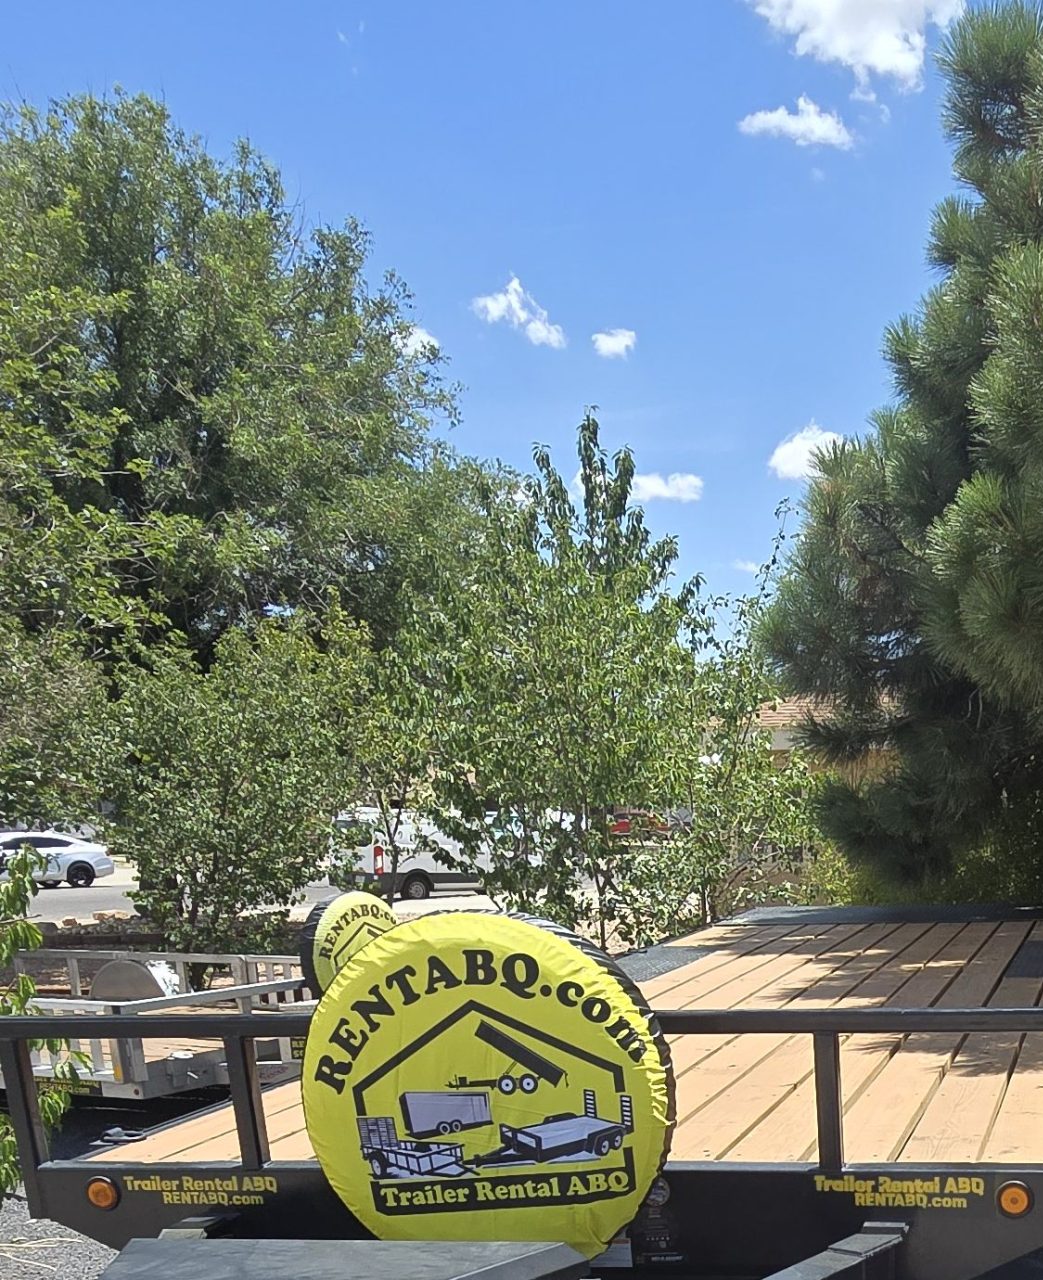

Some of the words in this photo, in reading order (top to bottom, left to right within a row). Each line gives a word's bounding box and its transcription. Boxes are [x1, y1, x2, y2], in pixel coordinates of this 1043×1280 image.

[319, 904, 396, 960] RENTABQ.co
[314, 949, 647, 1094] RENTABQ.com
[123, 1175, 179, 1191] Trailer
[182, 1175, 238, 1191] Rental
[242, 1176, 278, 1193] ABQ
[380, 1179, 470, 1208] Trailer
[475, 1174, 560, 1202] Rental
[566, 1169, 630, 1196] ABQ
[814, 1175, 875, 1192] Trailer
[878, 1176, 940, 1194] Rental
[943, 1177, 985, 1196] ABQ
[162, 1191, 264, 1206] RENTABQ.com
[855, 1192, 967, 1208] RENTABQ.com
